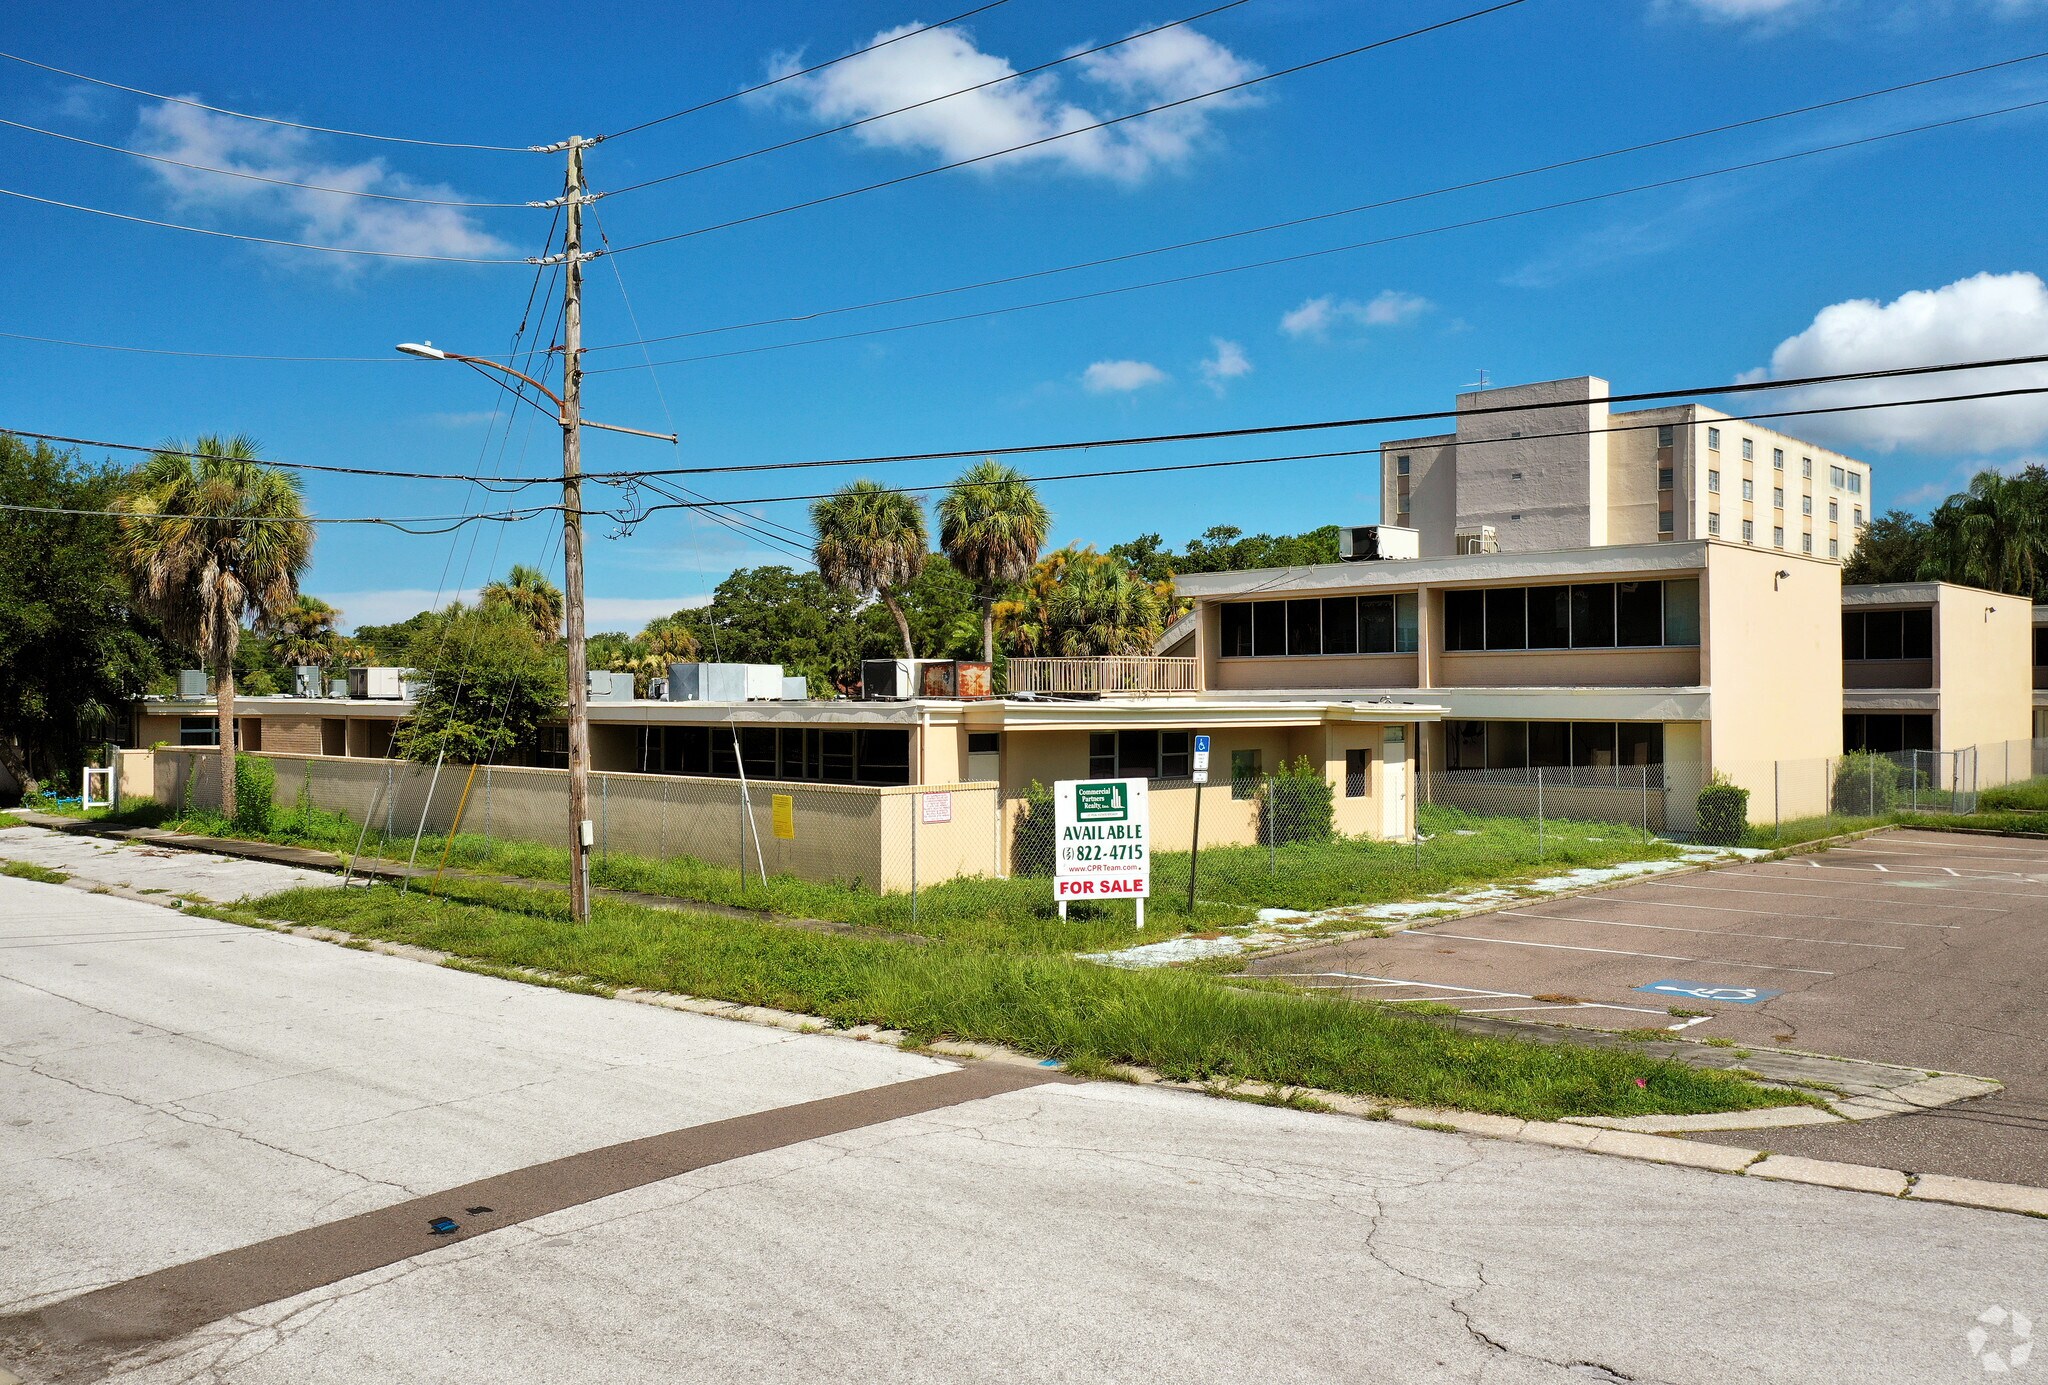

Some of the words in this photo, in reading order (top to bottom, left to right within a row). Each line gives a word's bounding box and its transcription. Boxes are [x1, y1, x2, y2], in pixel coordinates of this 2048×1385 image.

[1078, 788, 1111, 796] Commercial
[1063, 825, 1142, 840] AVAILABLE
[1077, 845, 1142, 861] 822-4715
[1060, 881, 1094, 894] FOR
[1100, 879, 1143, 893] SALE
